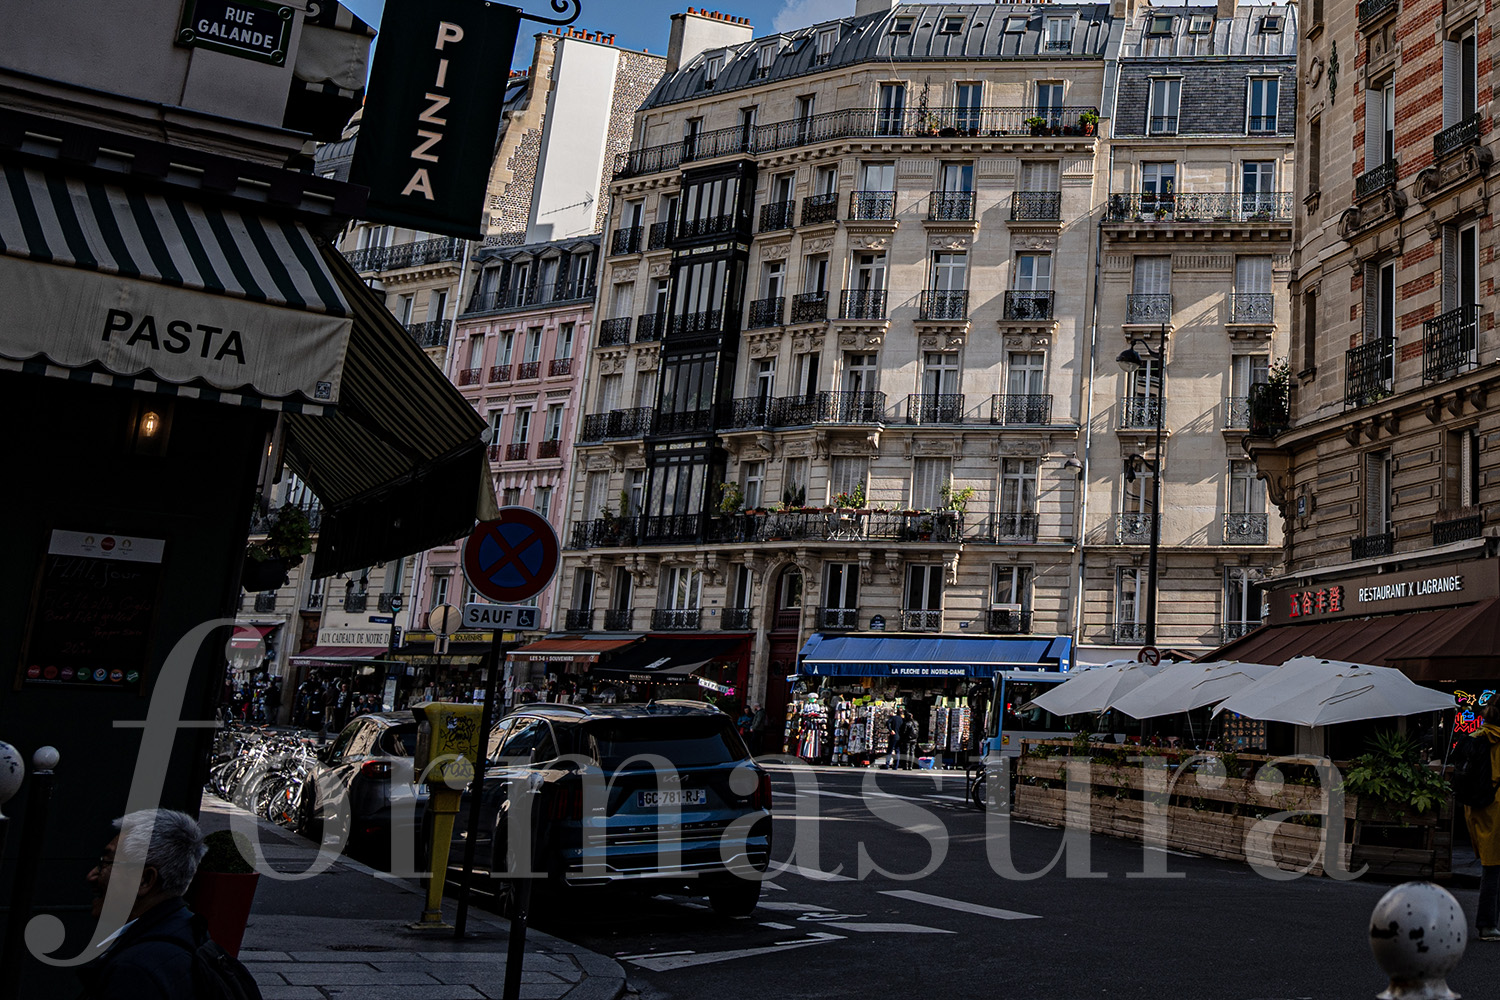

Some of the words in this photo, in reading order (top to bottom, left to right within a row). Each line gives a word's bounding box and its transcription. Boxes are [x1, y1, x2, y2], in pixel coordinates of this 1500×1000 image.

[225, 6, 255, 26] RUE
[198, 19, 274, 49] GALANDE
[400, 21, 465, 202] PIZZA
[102, 308, 246, 365] PASTA
[1289, 586, 1342, 617] 五谷丰登
[1358, 582, 1406, 602] RESTAURANT
[1407, 583, 1414, 597] X
[1417, 576, 1462, 596] LAGRANGE
[470, 608, 513, 624] SAUF
[321, 632, 331, 644] AUX
[332, 632, 356, 644] CADEAUX
[356, 632, 364, 644] DE
[365, 632, 383, 644] NOTRE
[455, 633, 483, 642] SOUVENIRS
[930, 668, 966, 676] NOTRE-DAME
[645, 790, 700, 806] GC-781-RJ
